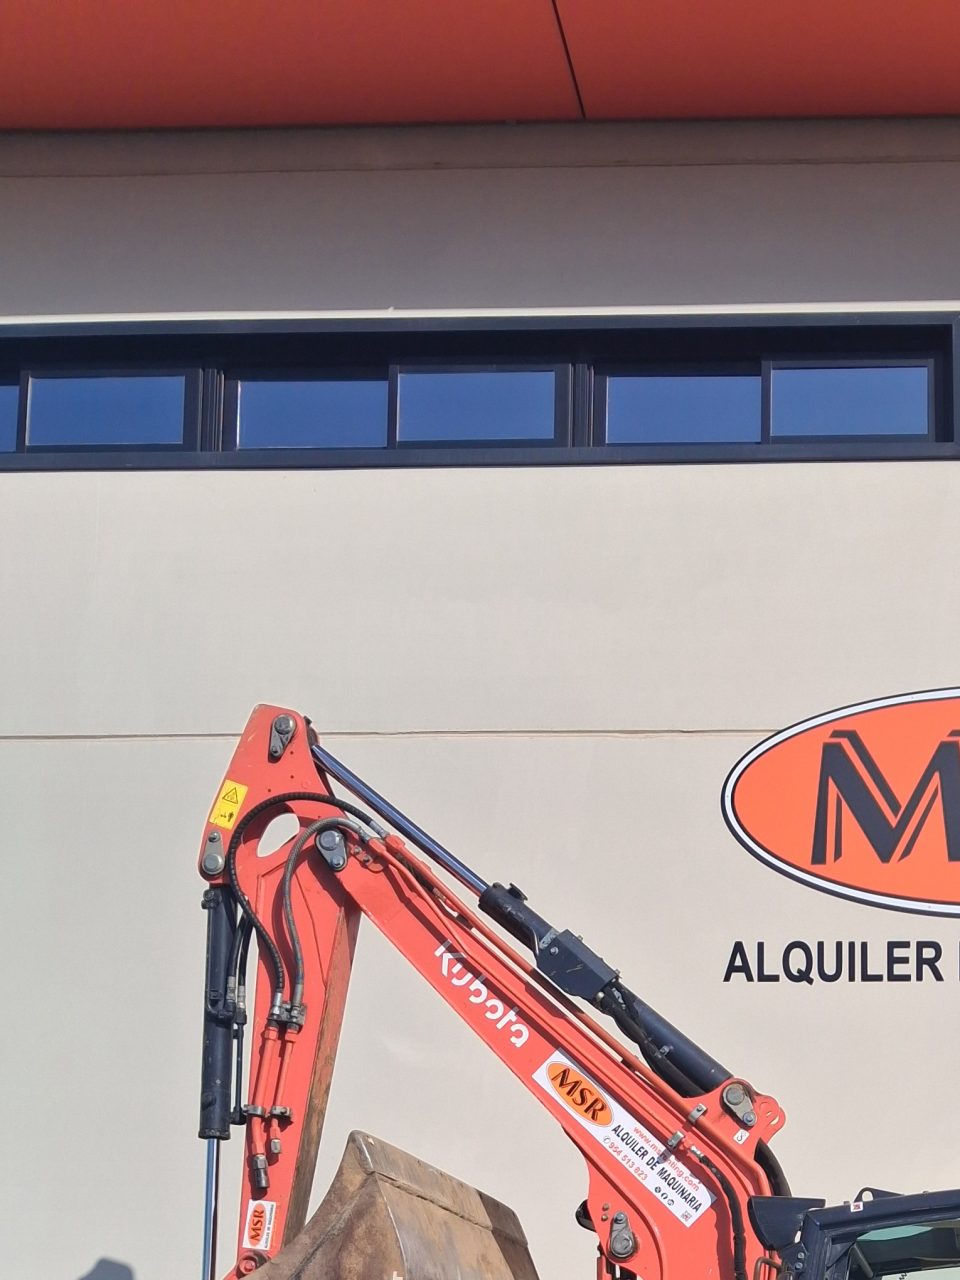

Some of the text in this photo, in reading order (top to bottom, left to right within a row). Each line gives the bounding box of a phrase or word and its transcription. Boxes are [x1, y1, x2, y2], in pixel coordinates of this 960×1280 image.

[723, 940, 944, 984] ALQUILER
[550, 1067, 608, 1122] MSR
[608, 1141, 621, 1157] 954
[621, 1153, 635, 1169] 513
[611, 1124, 703, 1213] ALQUILER DE MAQUINARIA
[250, 1210, 265, 1241] MSR
